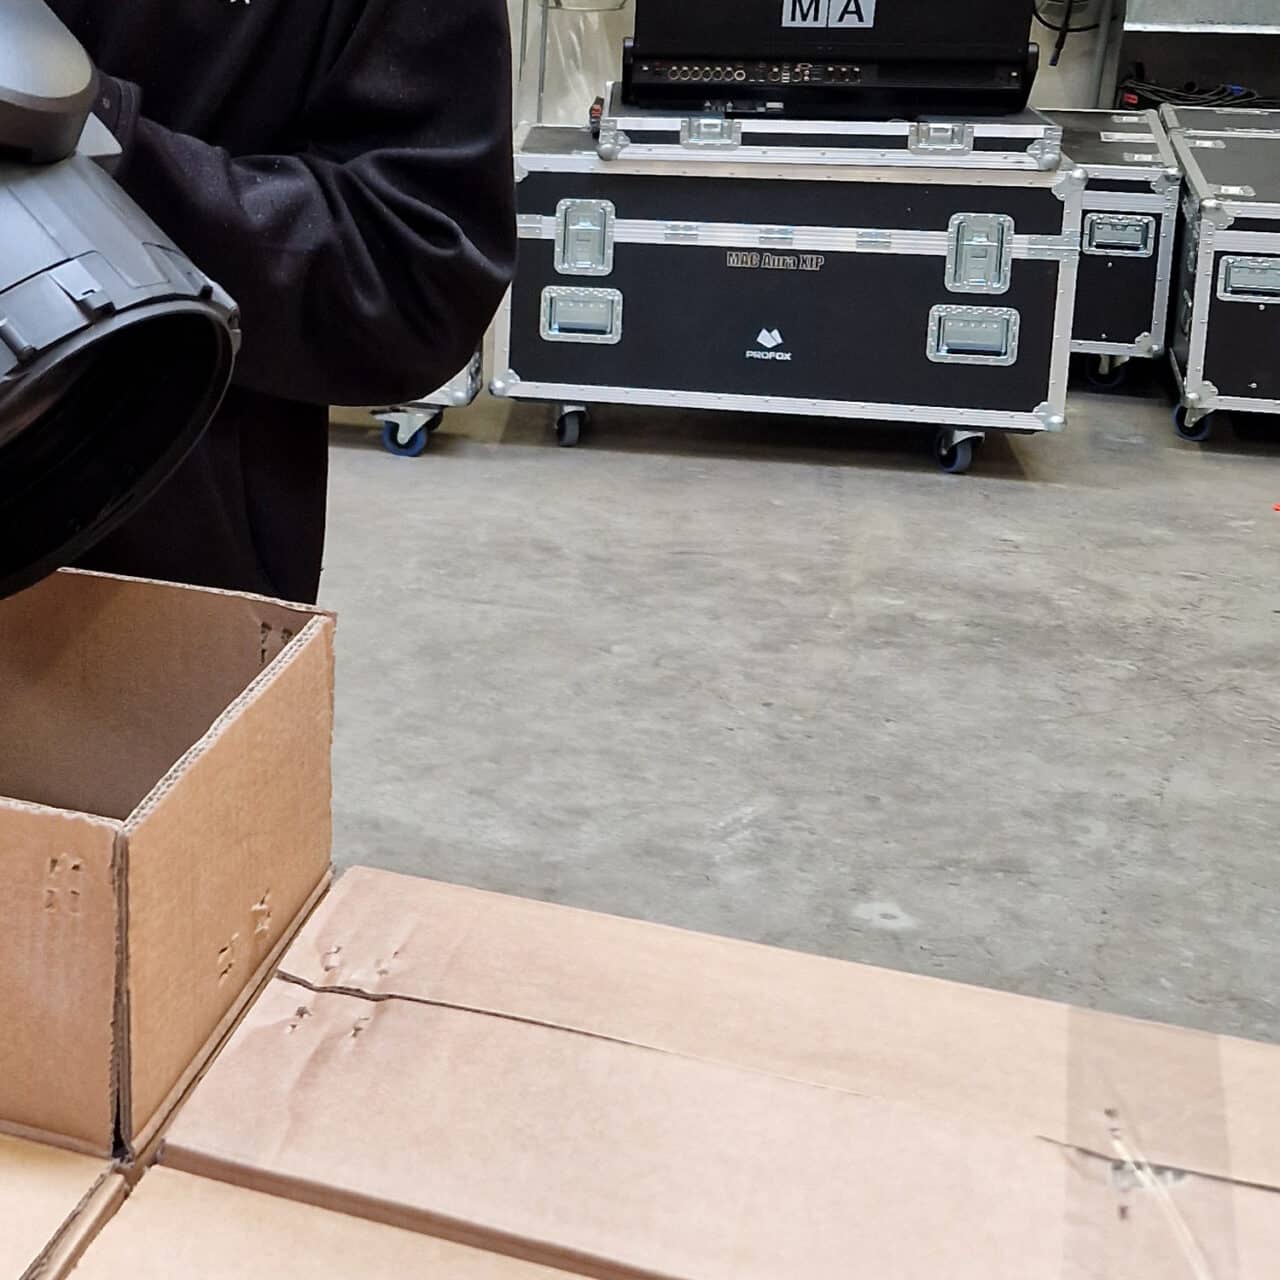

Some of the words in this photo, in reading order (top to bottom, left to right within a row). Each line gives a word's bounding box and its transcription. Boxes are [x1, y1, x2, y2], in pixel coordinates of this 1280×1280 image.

[726, 251, 760, 268] MAC
[760, 252, 797, 269] Aura
[745, 350, 792, 360] PROFOX
